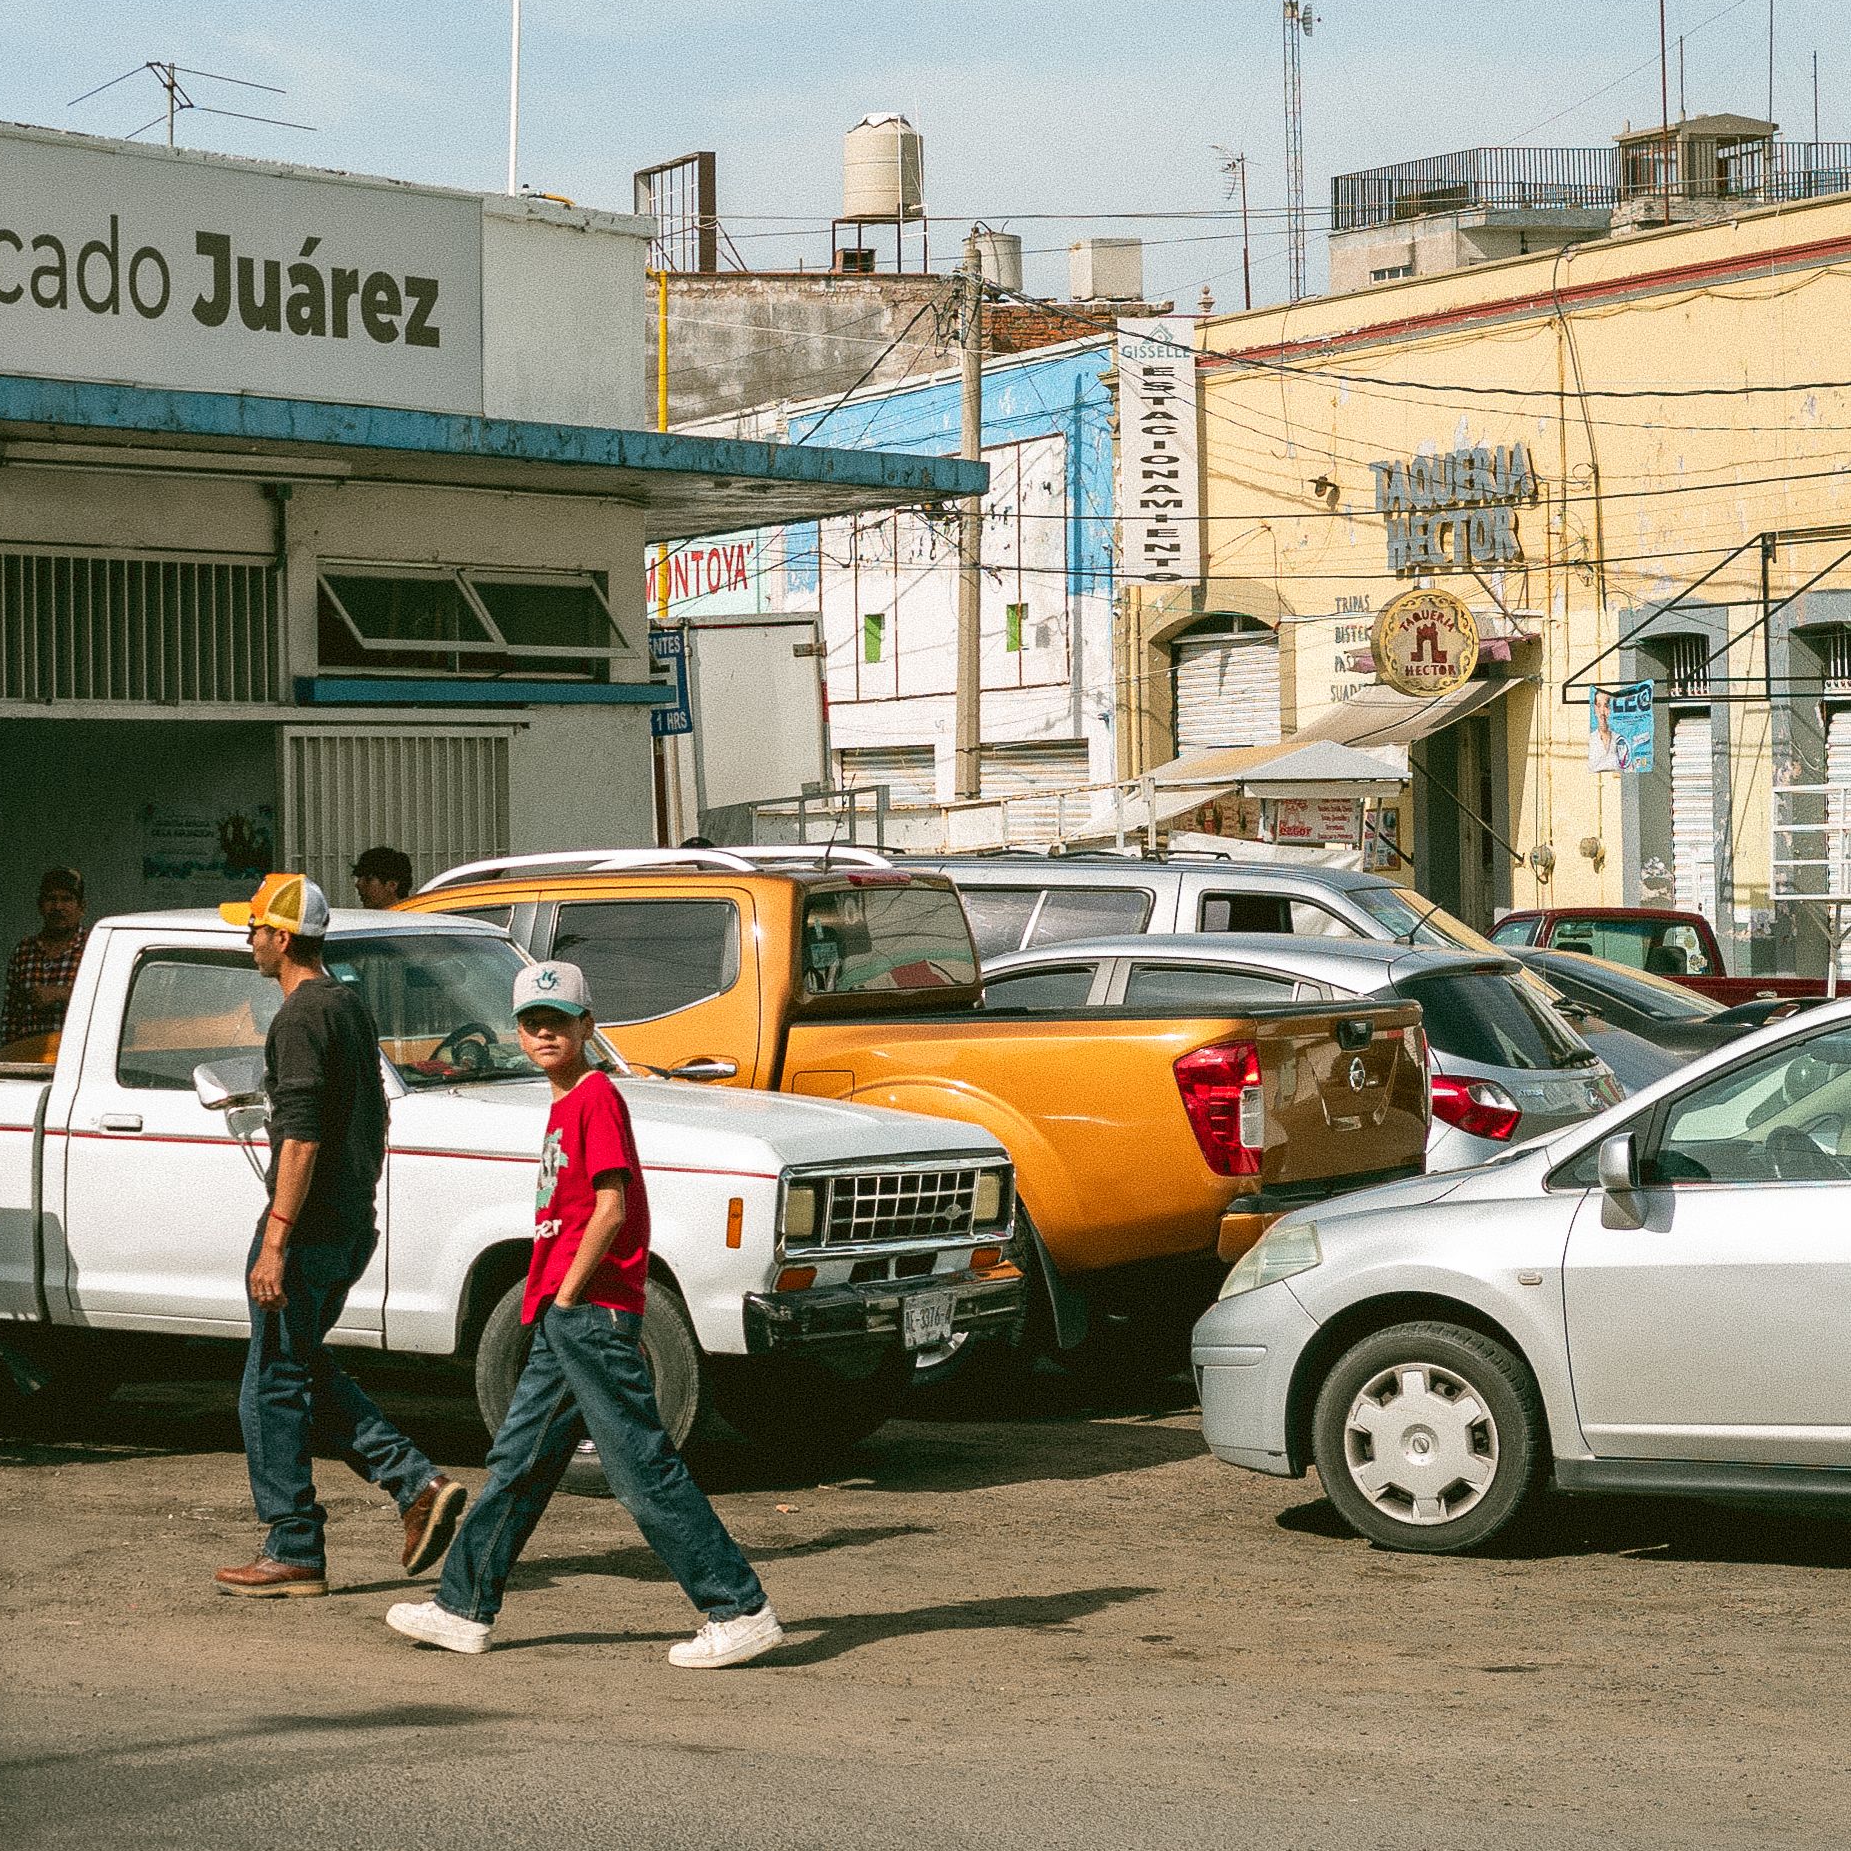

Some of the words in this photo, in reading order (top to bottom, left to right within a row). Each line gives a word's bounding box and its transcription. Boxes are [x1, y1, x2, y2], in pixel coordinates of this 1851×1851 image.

[192, 236, 440, 349] Juárez
[1139, 366, 1183, 583] ESTACIONAMIENTO
[1399, 609, 1457, 633] TAQUERIA
[1404, 664, 1457, 677] HECTOR
[667, 710, 688, 731] HRS
